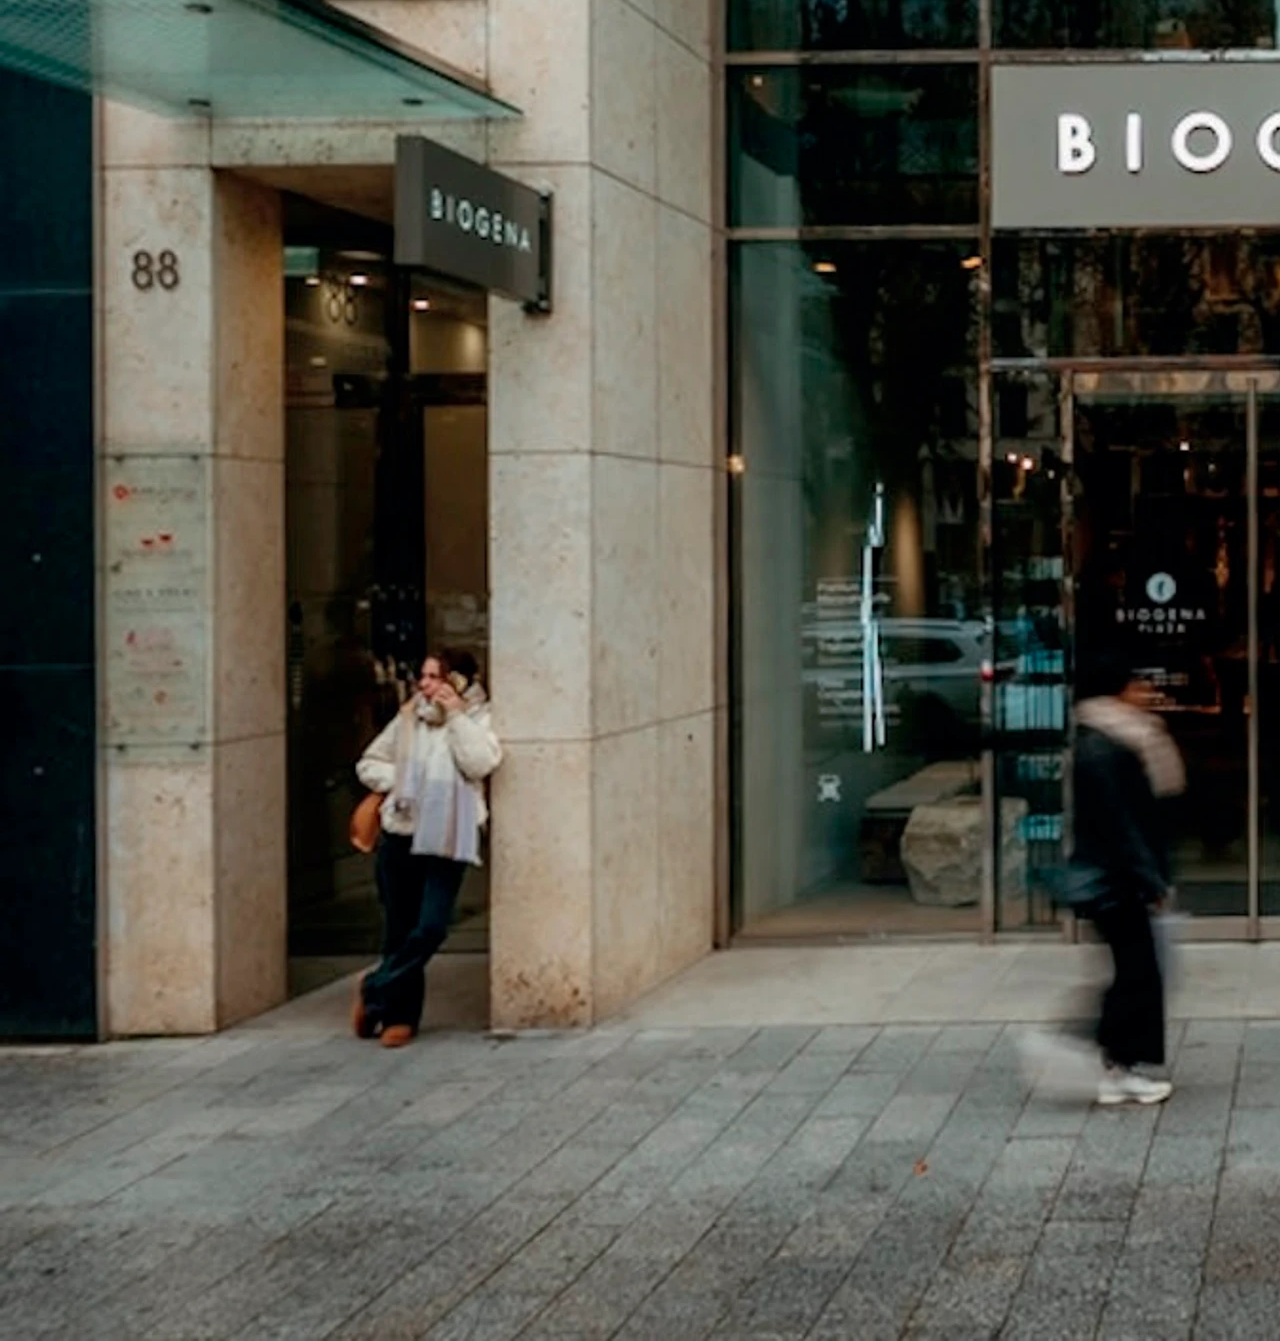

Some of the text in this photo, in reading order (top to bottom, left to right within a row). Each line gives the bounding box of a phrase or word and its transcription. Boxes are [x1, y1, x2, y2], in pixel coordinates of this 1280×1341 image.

[429, 187, 532, 254] BIOGENA
[131, 249, 180, 291] 88
[1115, 608, 1206, 623] BIOGENA
